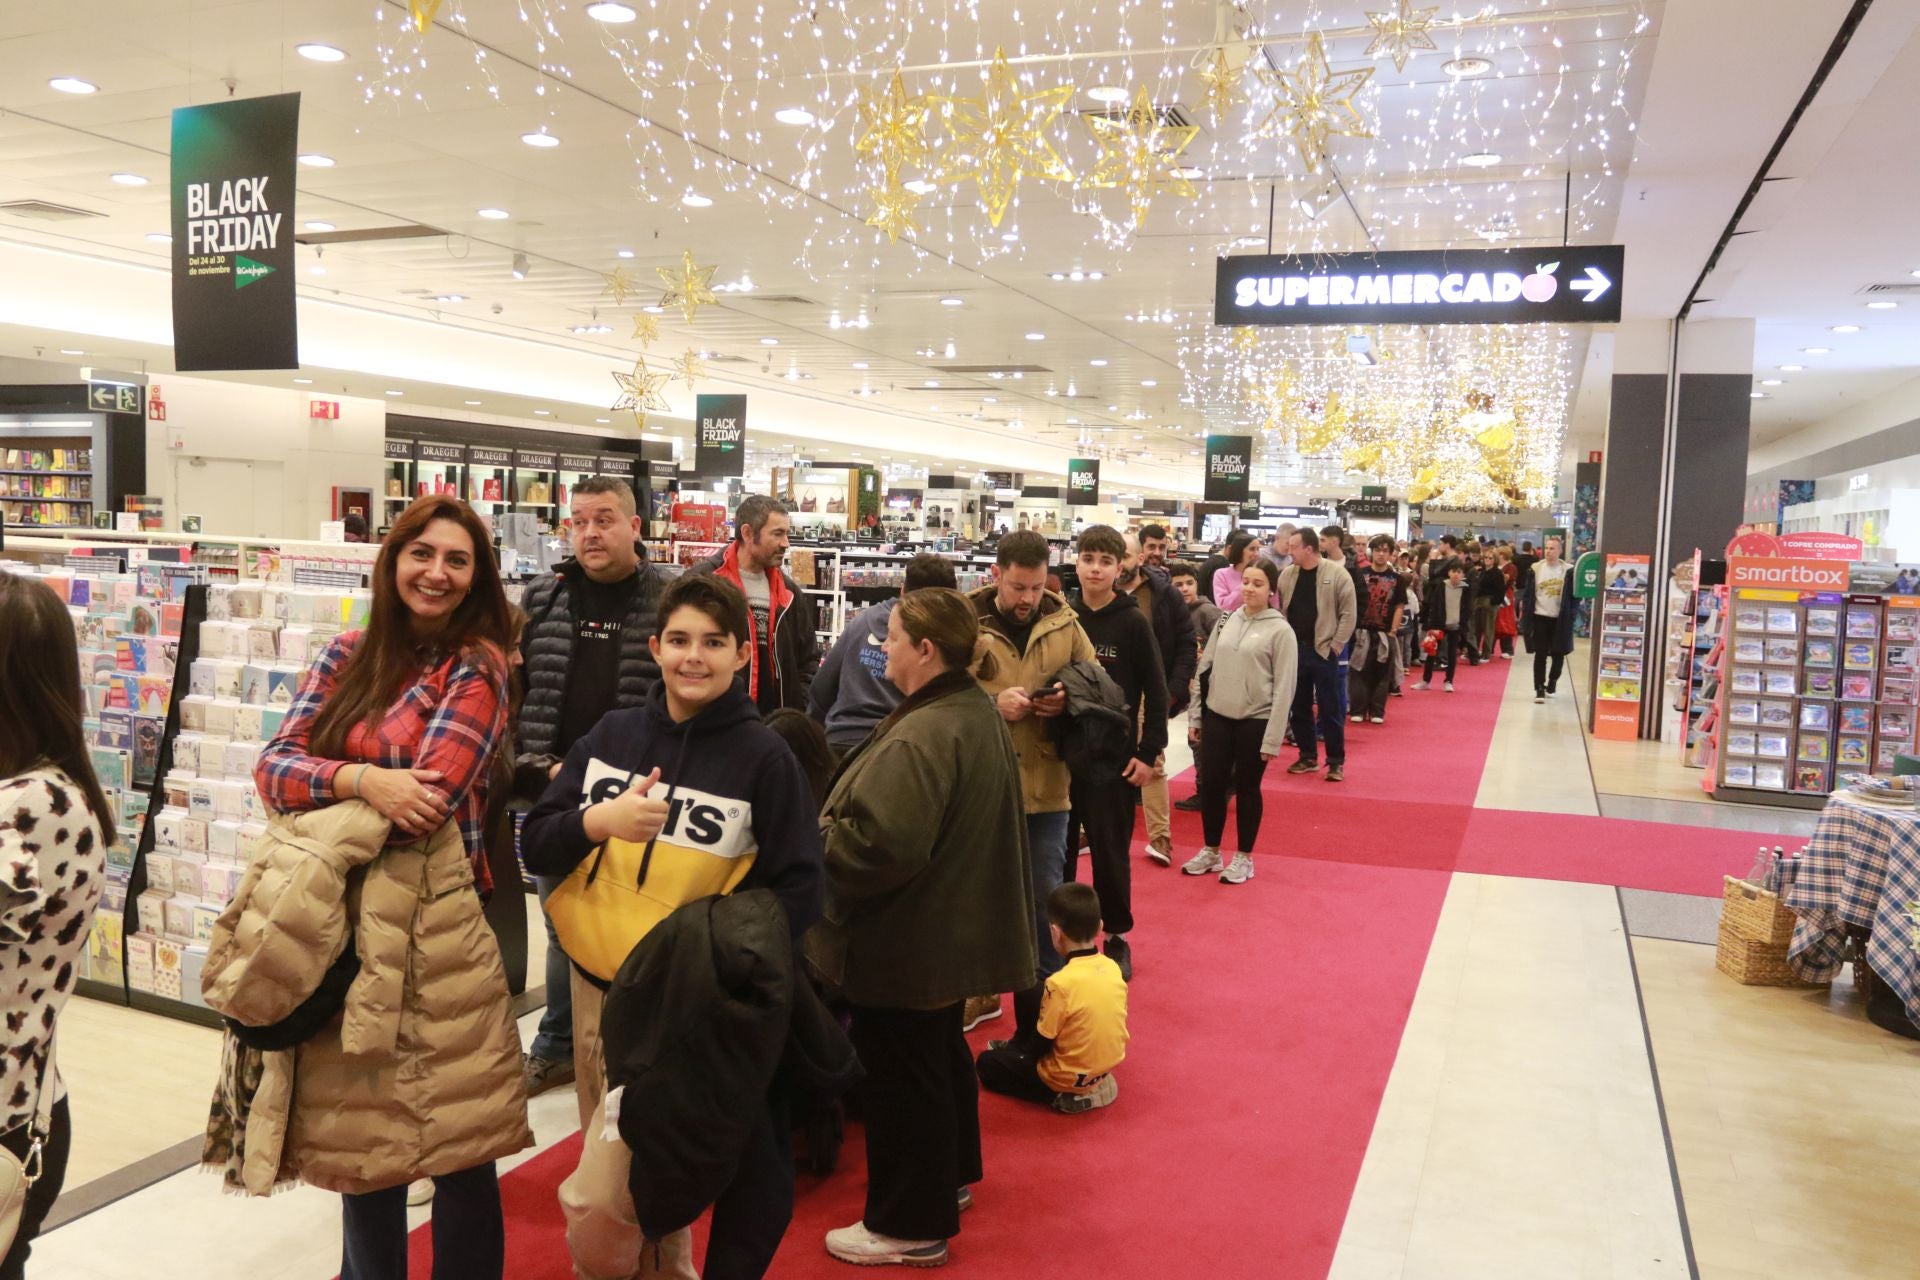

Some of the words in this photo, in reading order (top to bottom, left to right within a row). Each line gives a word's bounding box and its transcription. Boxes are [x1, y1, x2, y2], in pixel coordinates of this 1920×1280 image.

[187, 176, 269, 218] BLACK
[188, 213, 282, 254] FRIDAY
[189, 257, 199, 266] Del
[200, 257, 209, 265] 24
[216, 255, 225, 264] 30
[198, 266, 230, 275] noviembre
[703, 418, 736, 430] BLACK
[703, 430, 741, 441] FRIDAY
[423, 446, 460, 458] DRAEGER
[474, 450, 508, 462] DRAEGER
[521, 454, 552, 465] DRAEGER
[563, 458, 593, 468] DRAEGER
[1212, 454, 1242, 465] BLACK
[603, 461, 631, 471] DRAEGER
[1212, 463, 1246, 474] FRIDAY
[1072, 471, 1094, 479] BLACK
[1072, 478, 1097, 486] FRIDAY
[1788, 541, 1813, 549] COFRE
[1814, 541, 1858, 550] COMPRADO
[1735, 565, 1843, 585] smartbox
[1600, 714, 1634, 723] smartbox
